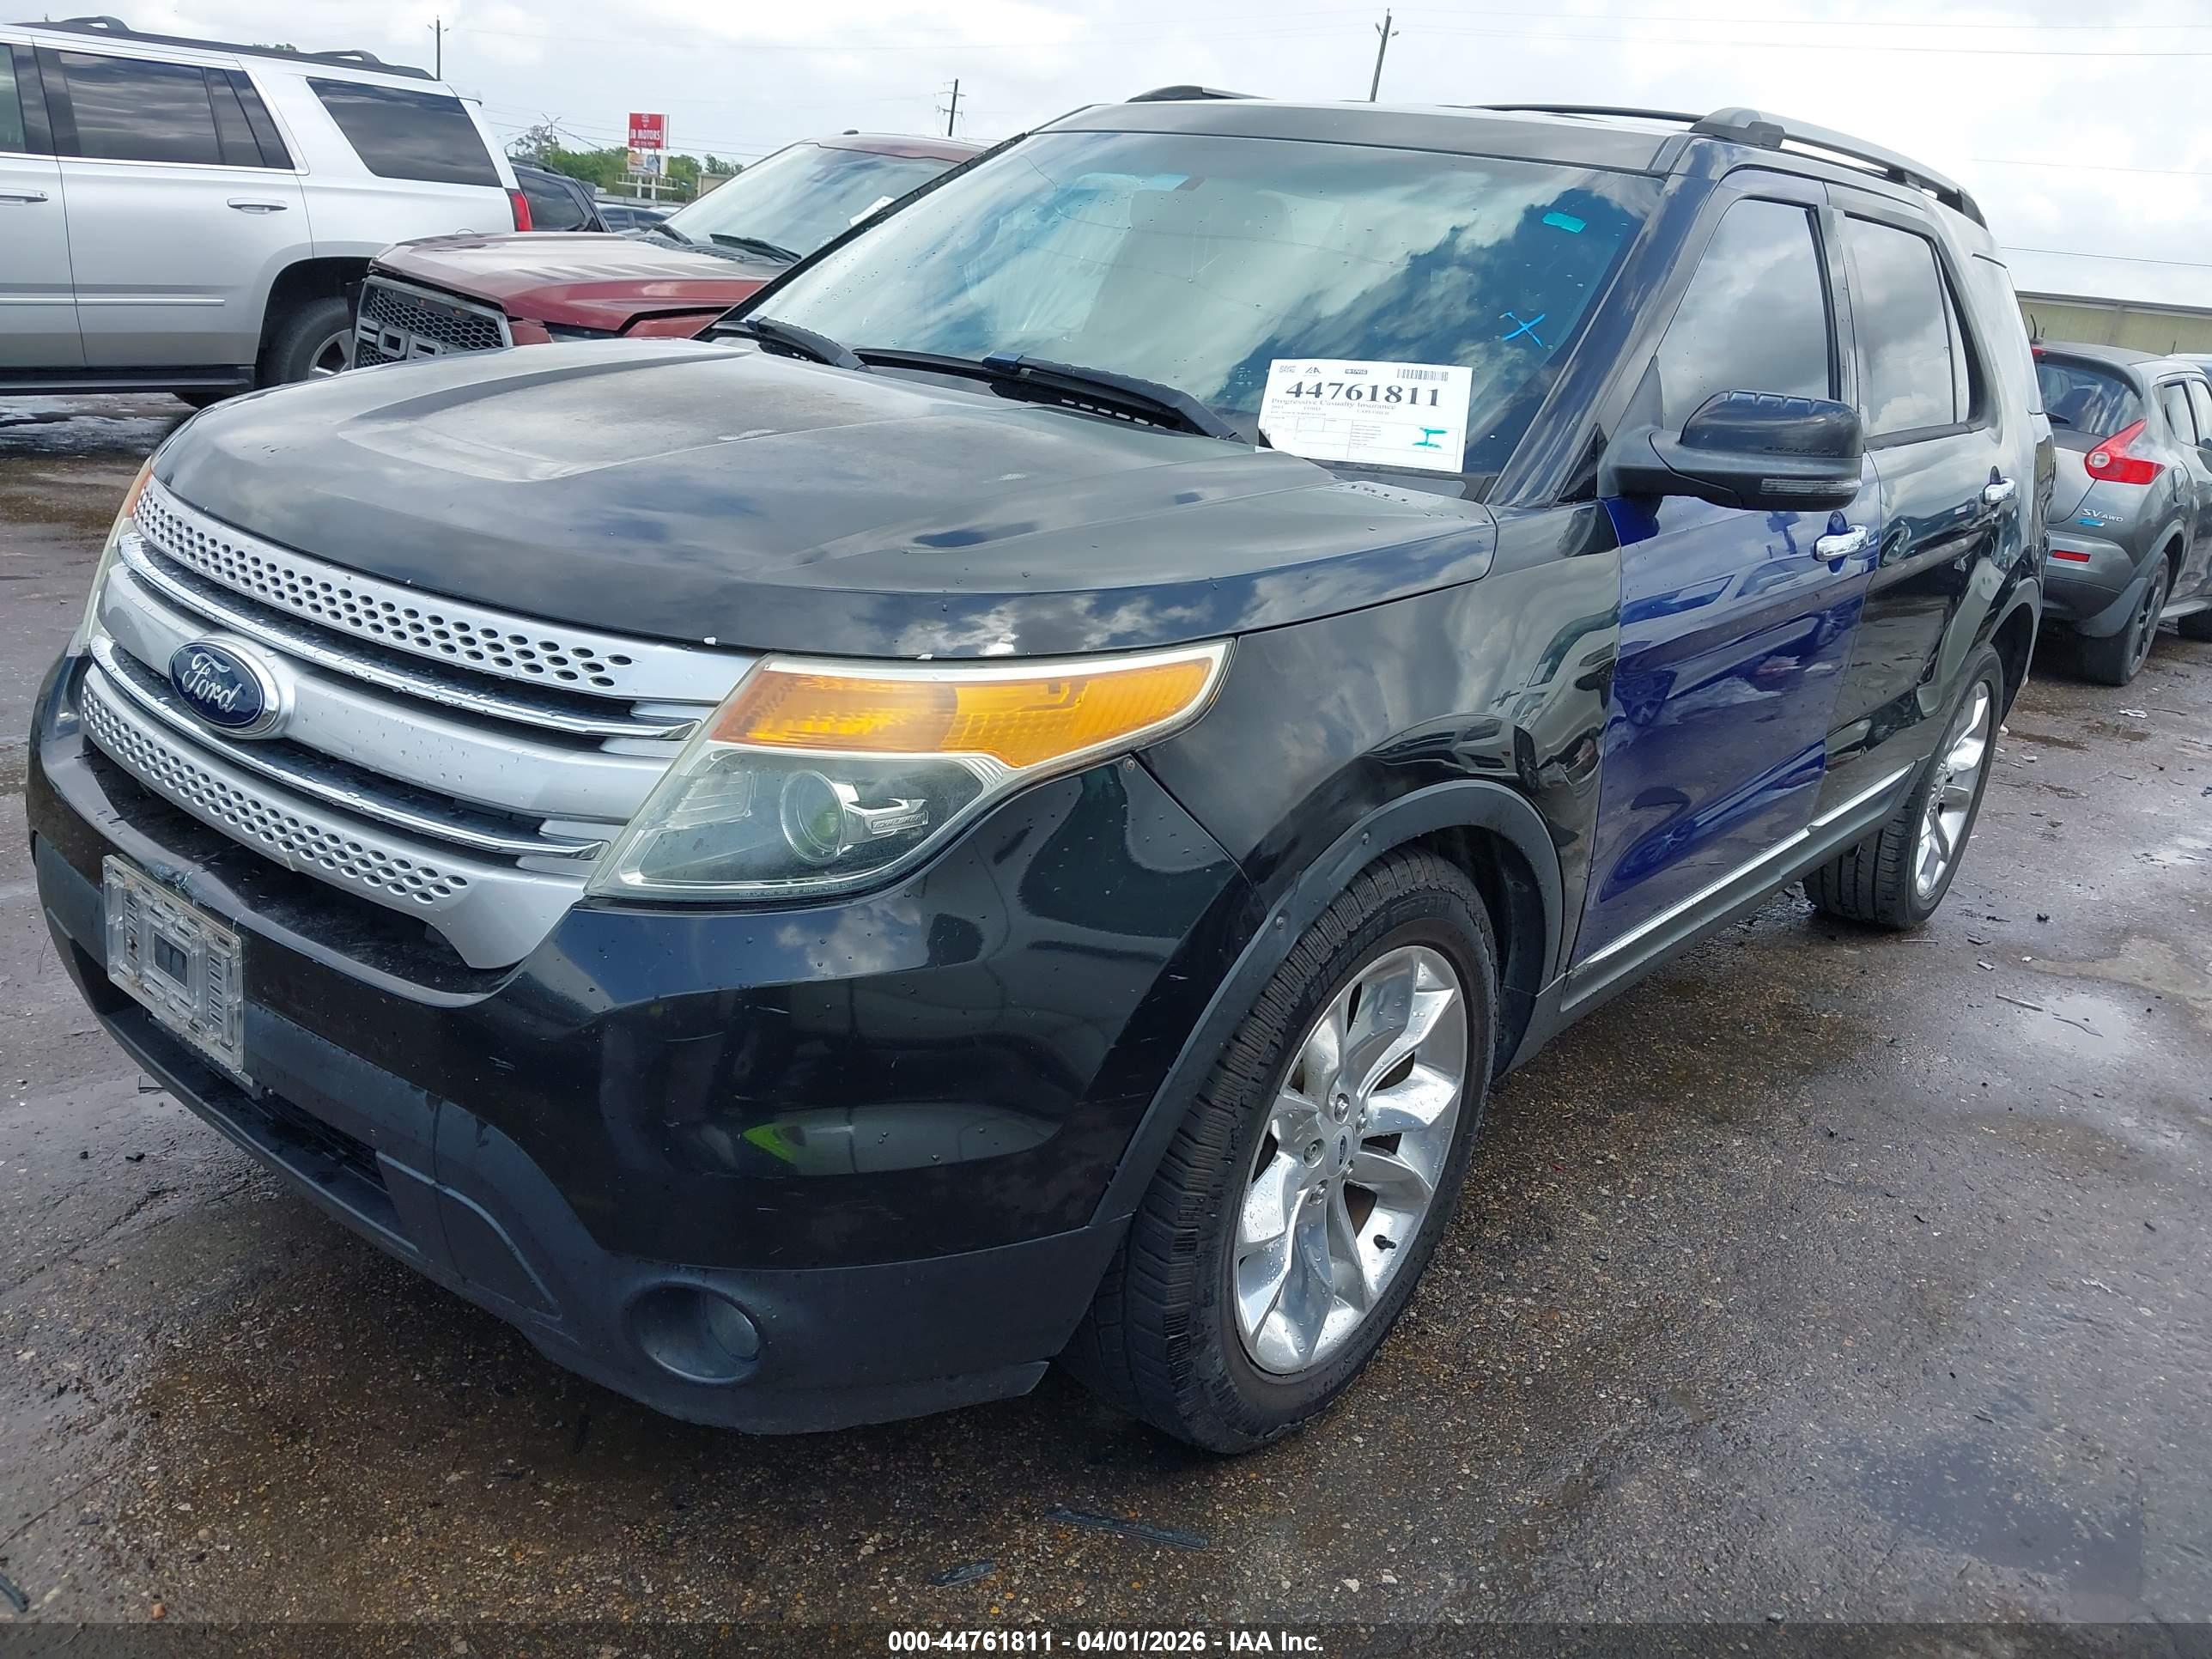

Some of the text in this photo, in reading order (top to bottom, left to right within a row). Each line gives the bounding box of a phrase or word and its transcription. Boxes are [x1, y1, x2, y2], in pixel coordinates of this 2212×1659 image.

[637, 129, 660, 141] MOTORS
[356, 316, 445, 361] FOR
[1271, 398, 1396, 410] Progressive Casualty Insurance
[1285, 381, 1442, 407] 44761811
[2081, 508, 2124, 522] SV AWD
[181, 652, 242, 714] Ford
